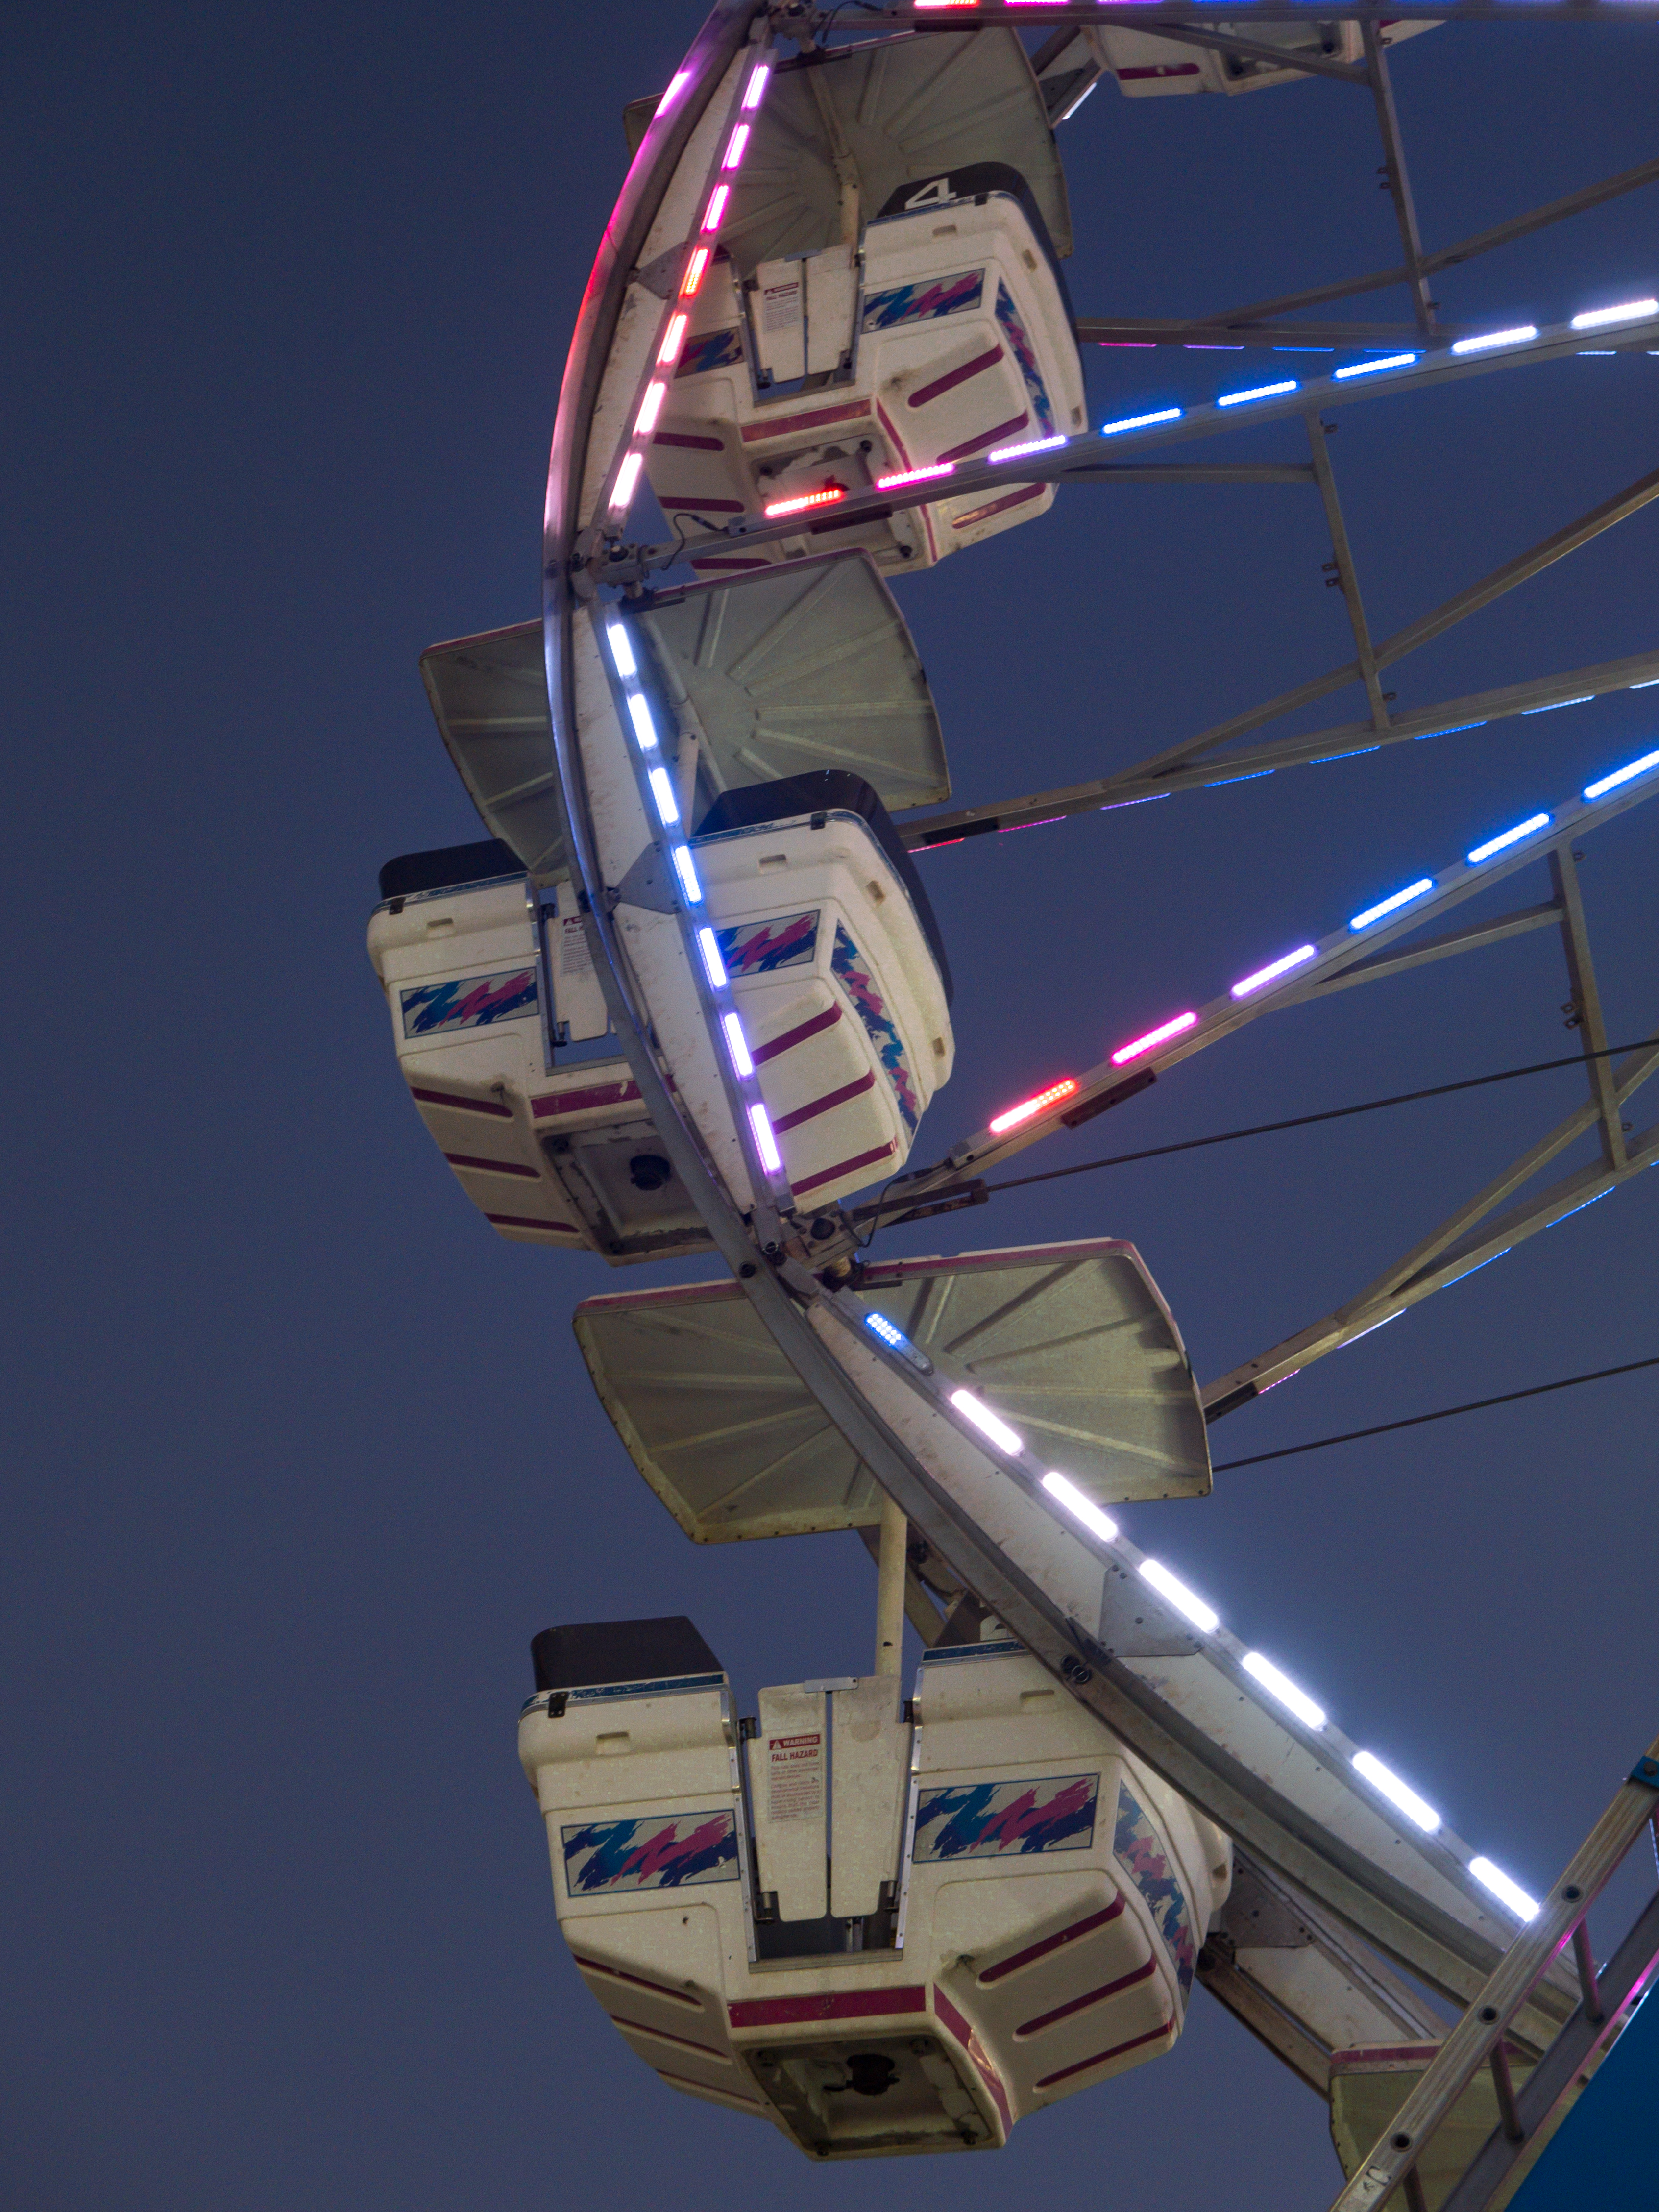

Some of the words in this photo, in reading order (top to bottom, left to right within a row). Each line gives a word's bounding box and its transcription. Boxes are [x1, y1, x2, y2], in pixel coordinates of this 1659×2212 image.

[904, 177, 957, 210] 4
[783, 1736, 818, 1747] WARNING
[771, 1753, 787, 1762] FALL
[790, 1749, 818, 1760] HAZARD
